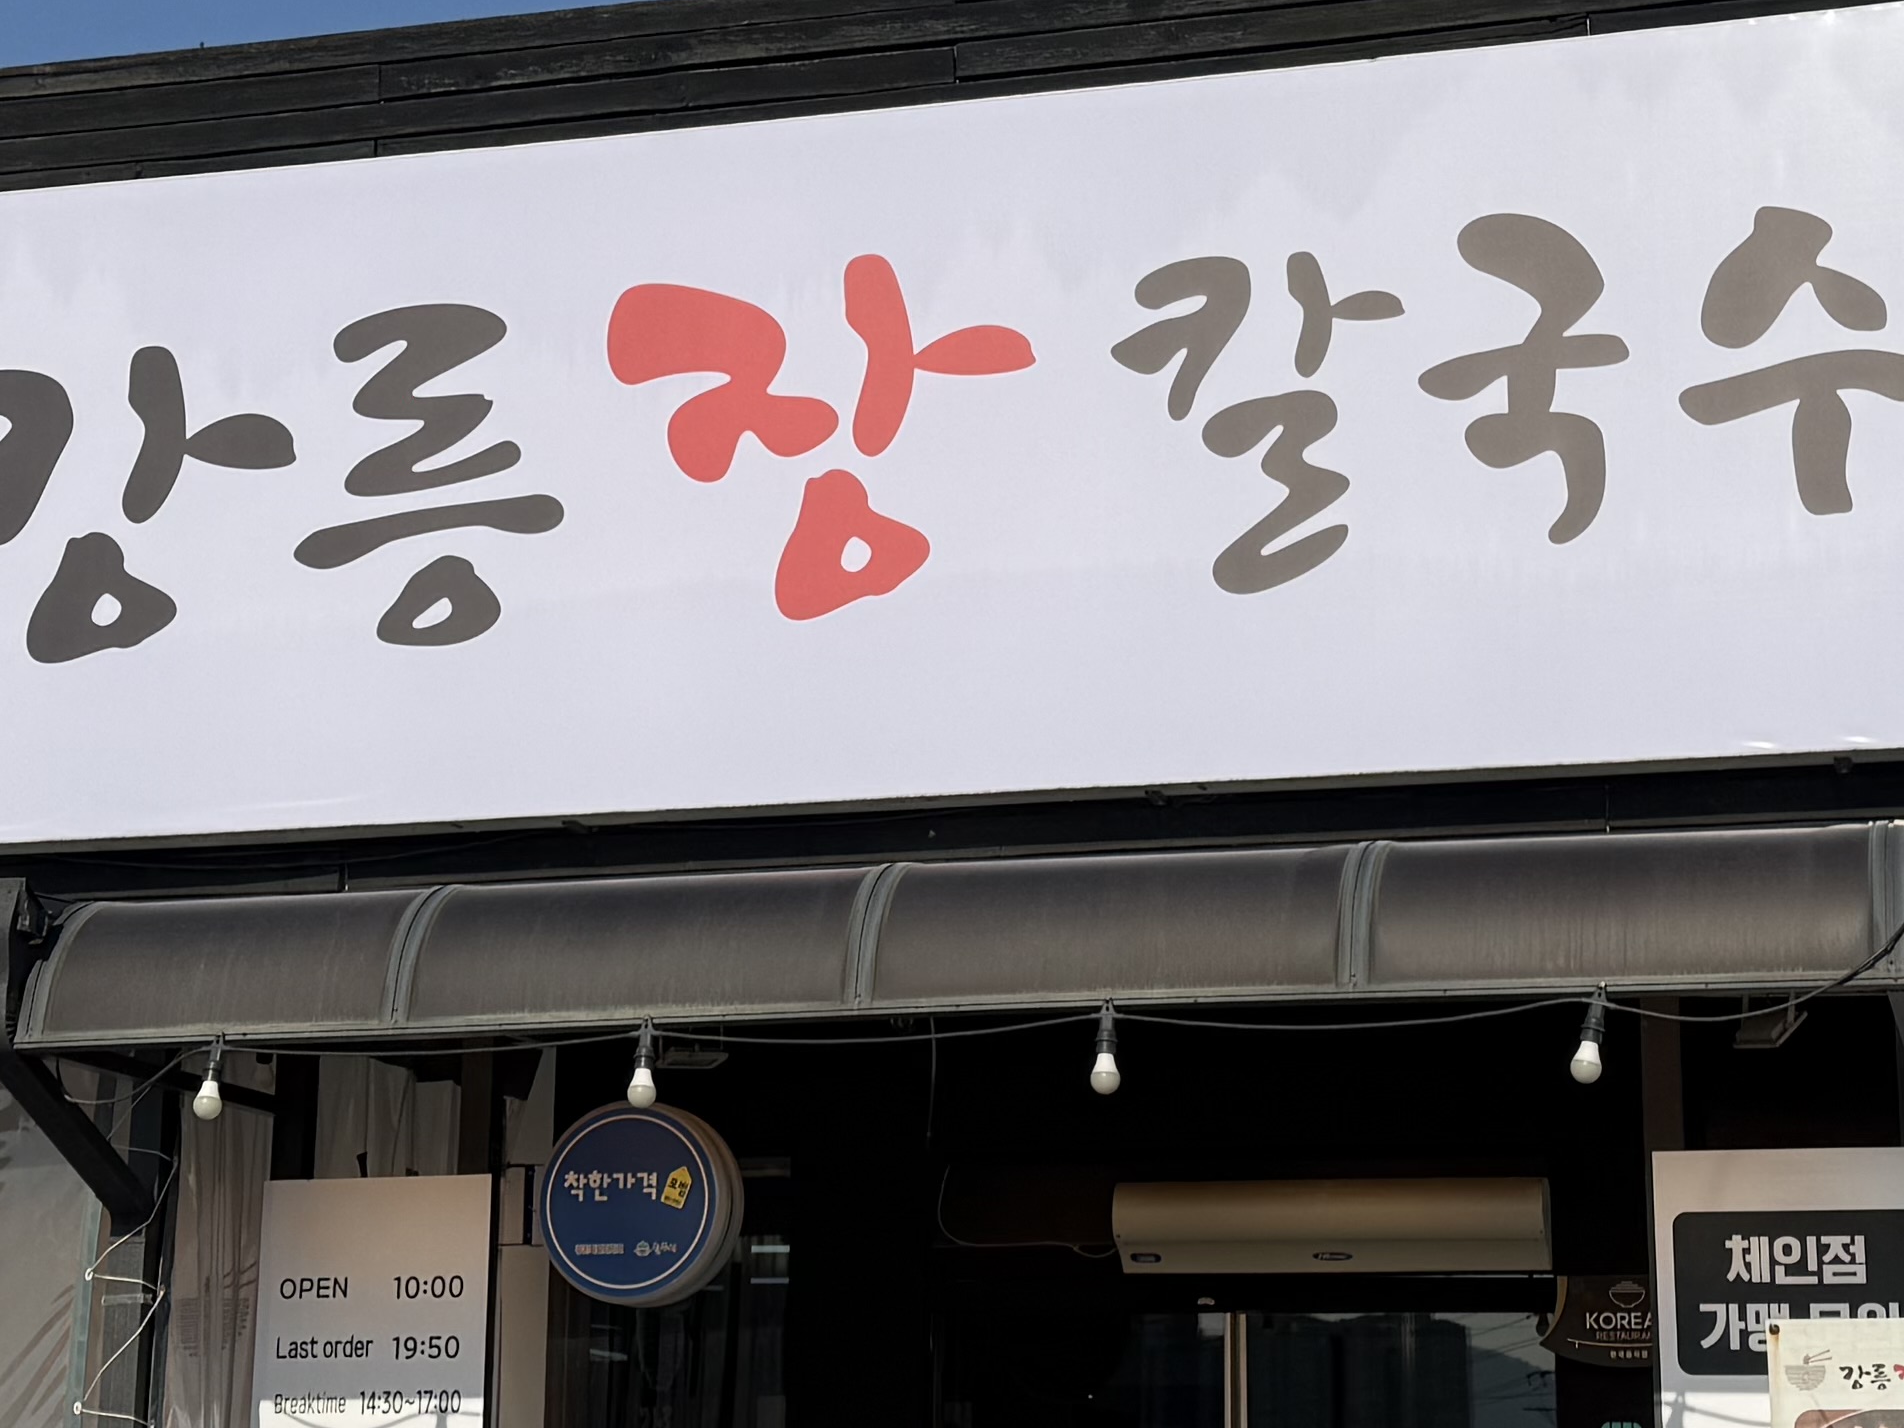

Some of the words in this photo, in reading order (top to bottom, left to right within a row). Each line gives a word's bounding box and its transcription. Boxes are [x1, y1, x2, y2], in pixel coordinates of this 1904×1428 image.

[564, 1170, 657, 1202] 착한가격
[1725, 1234, 1867, 1284] 체인점
[280, 1277, 348, 1299] OPEN
[394, 1275, 464, 1299] 10:00
[276, 1336, 318, 1359] Last
[323, 1335, 373, 1359] order
[392, 1336, 460, 1359] 19:50
[274, 1392, 346, 1414] Breaktime
